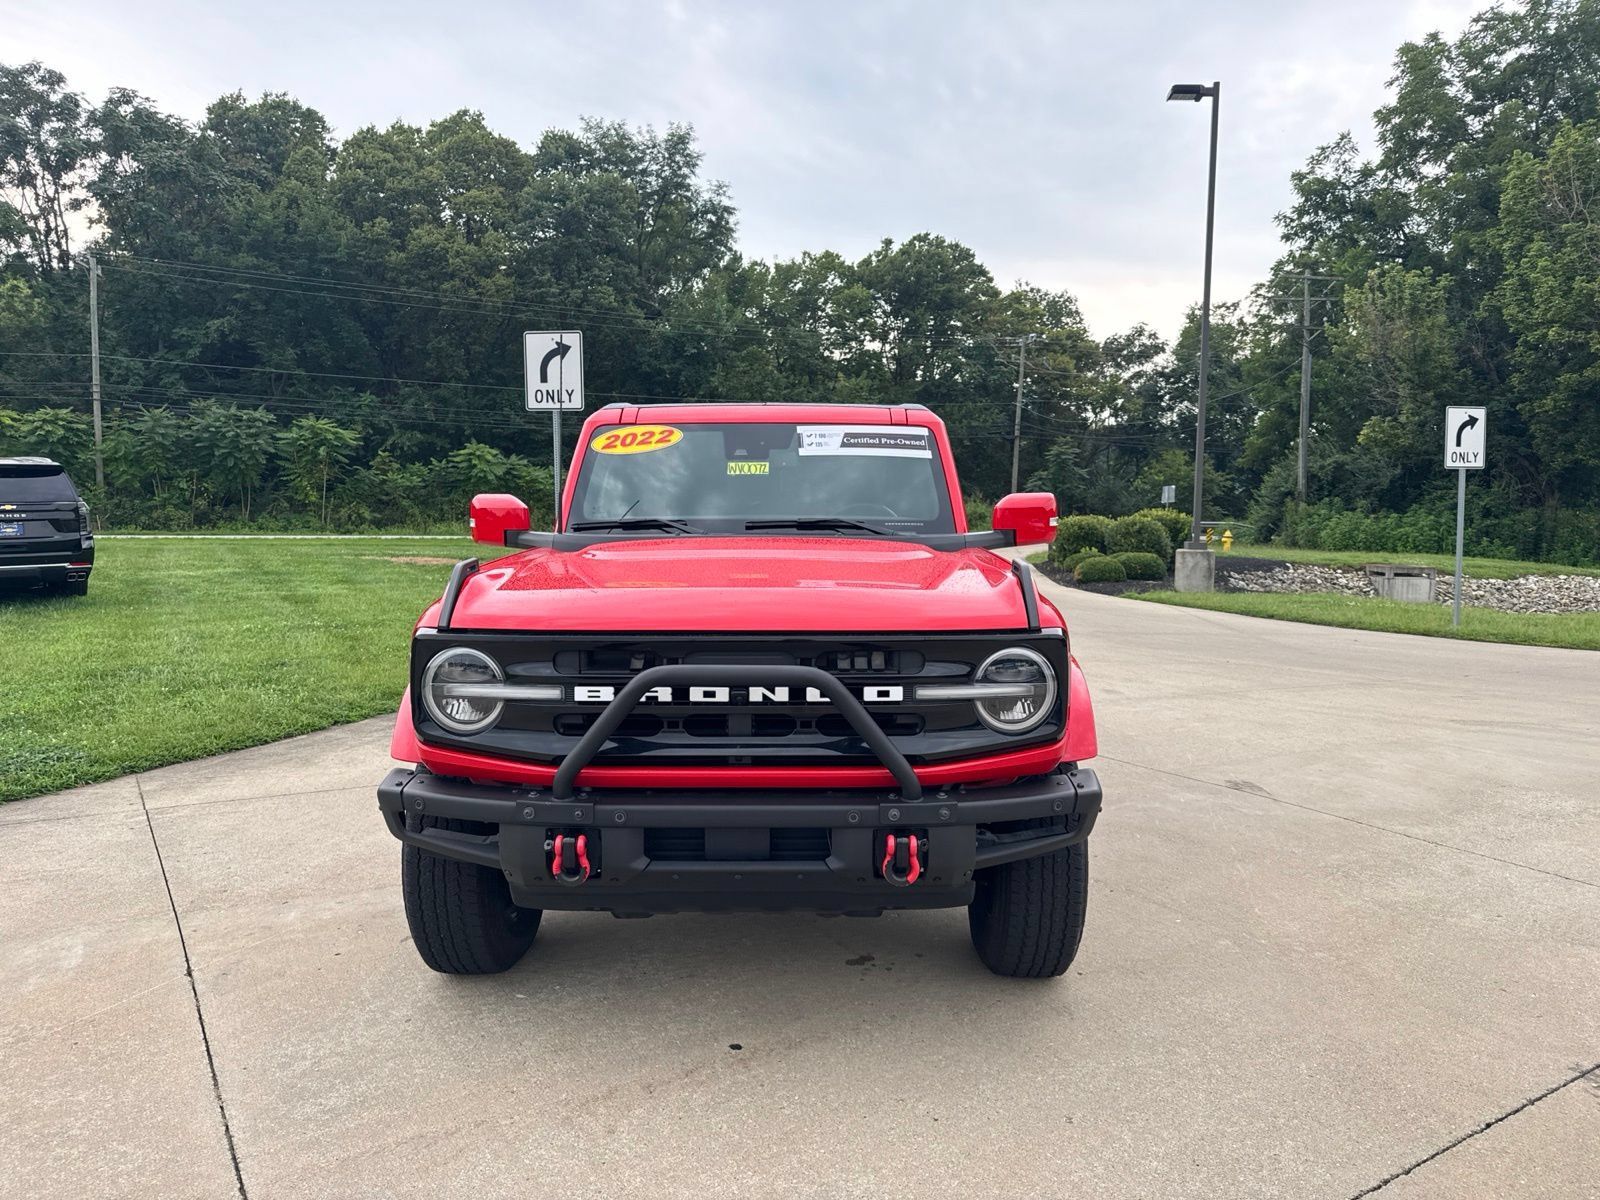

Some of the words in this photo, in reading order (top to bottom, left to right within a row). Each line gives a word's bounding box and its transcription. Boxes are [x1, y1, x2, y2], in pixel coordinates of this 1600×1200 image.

[534, 389, 575, 404] ONLY
[601, 429, 675, 450] 2022
[881, 438, 925, 446] Pre-Owned
[1451, 451, 1479, 464] ONLY
